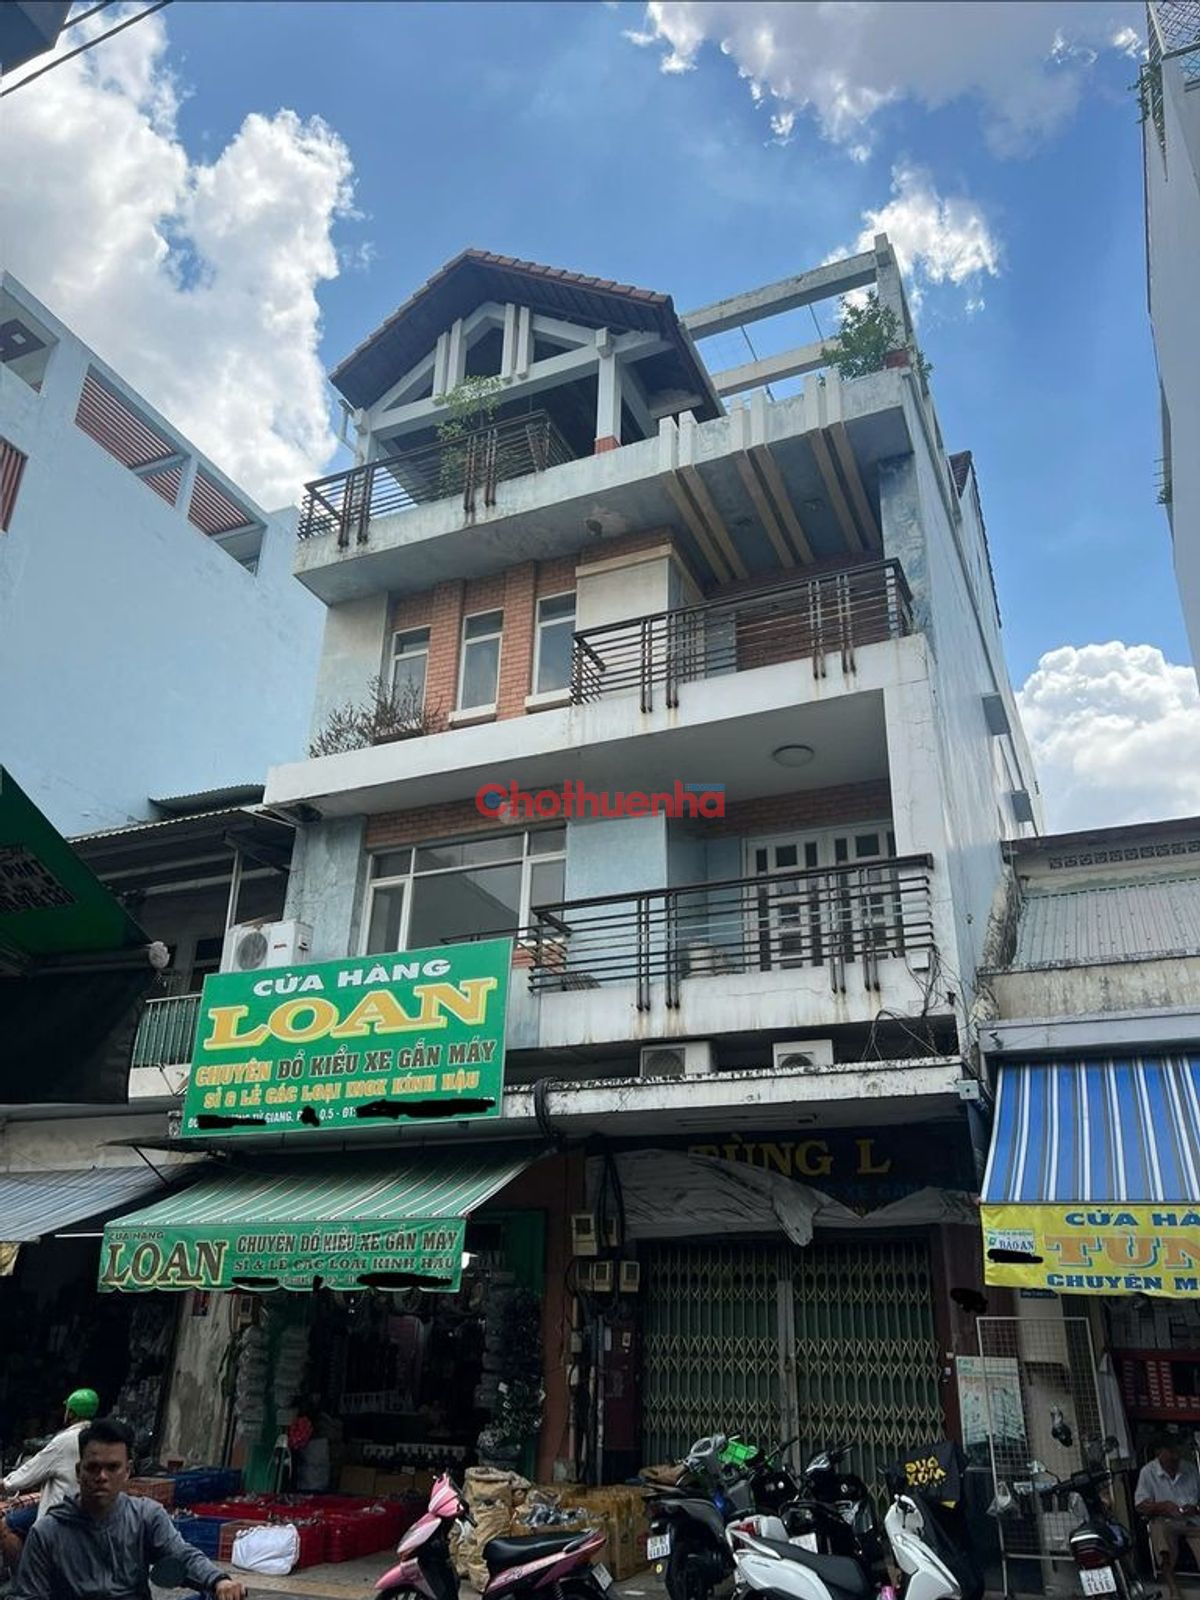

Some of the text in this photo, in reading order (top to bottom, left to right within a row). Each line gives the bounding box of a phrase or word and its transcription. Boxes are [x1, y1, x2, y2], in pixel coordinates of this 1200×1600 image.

[253, 958, 452, 997] CỬA HÀNG
[203, 976, 497, 1050] LOAN
[194, 1058, 273, 1087] CHUYÊN
[363, 1049, 393, 1073] XE
[398, 1038, 442, 1069] GẮN
[447, 1035, 497, 1066] MÁY
[265, 1082, 298, 1104] CÁC
[1065, 1209, 1139, 1226] CỬA
[236, 1229, 296, 1253] CHUYÊN
[101, 1239, 230, 1287] LOAN
[1047, 1273, 1163, 1291] CHUYÊN
